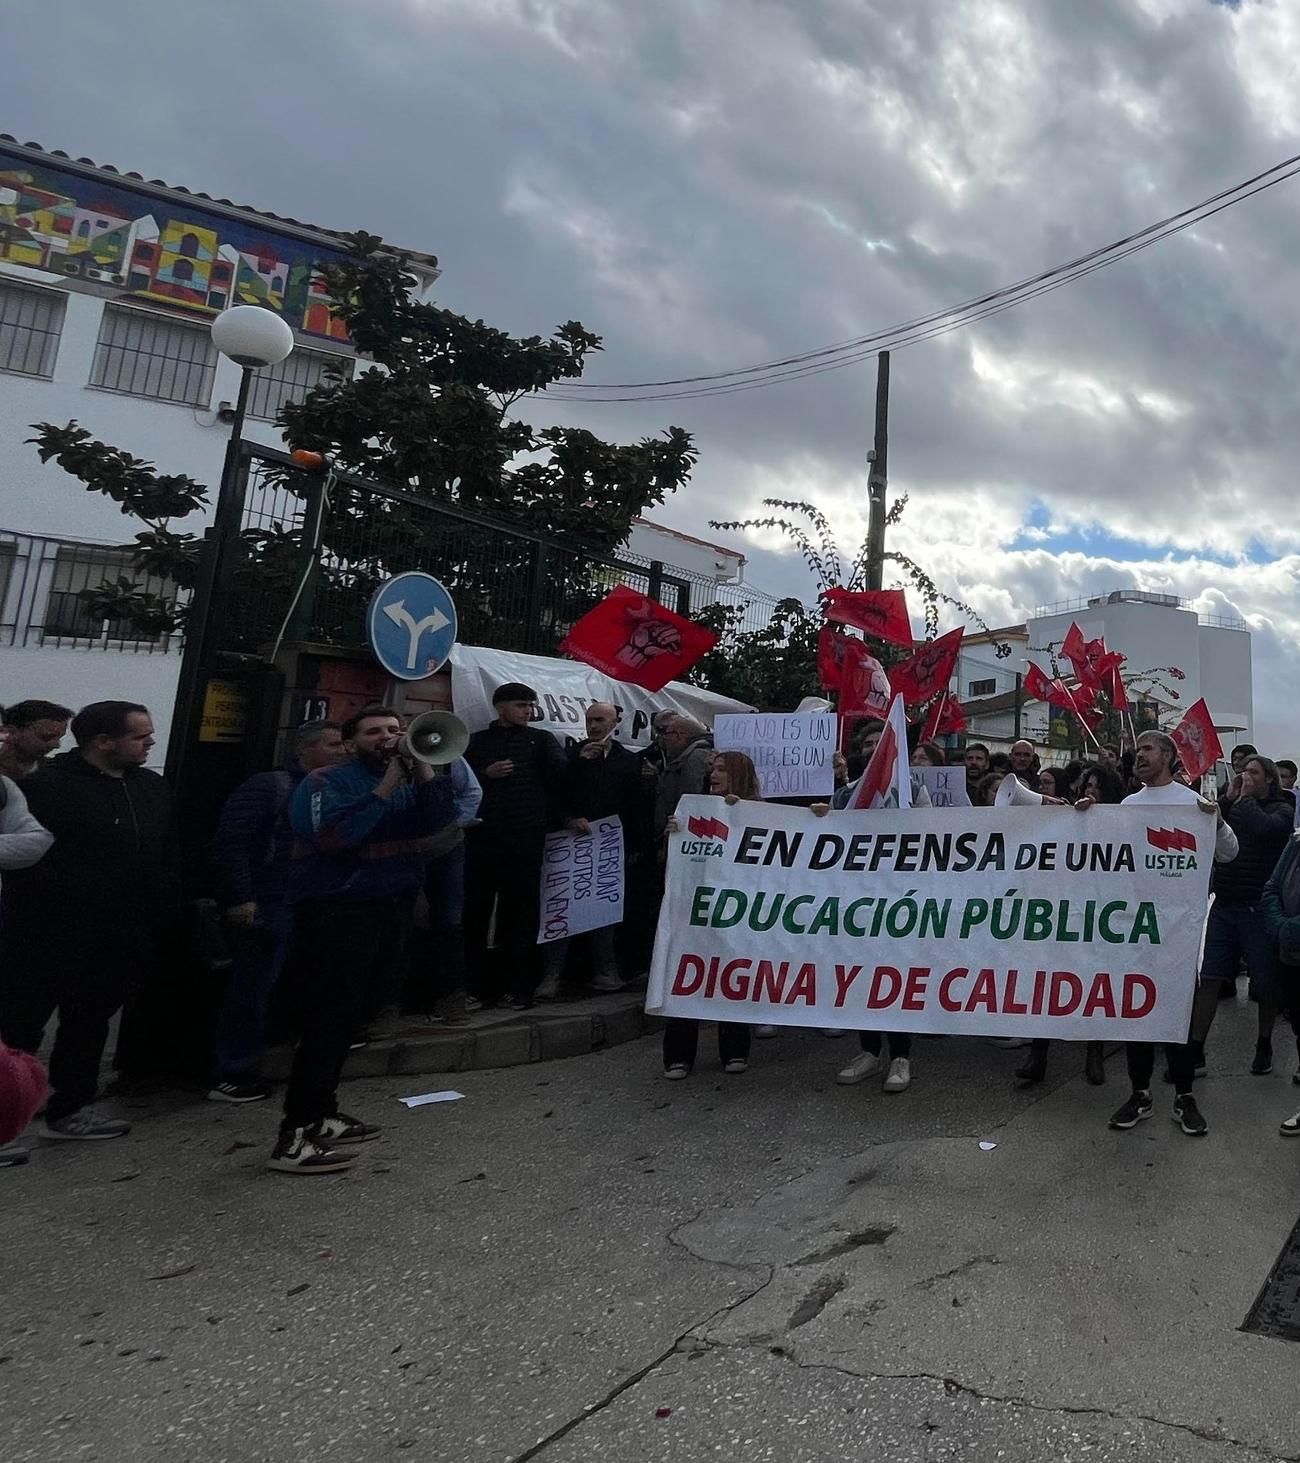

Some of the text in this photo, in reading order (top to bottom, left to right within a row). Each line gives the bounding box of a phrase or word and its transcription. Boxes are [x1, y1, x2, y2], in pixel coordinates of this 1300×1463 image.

[304, 700, 327, 721] 13
[753, 719, 777, 740] NO
[782, 718, 802, 740] ES
[809, 718, 831, 741] UN
[782, 746, 801, 766] ES
[804, 747, 825, 767] UN
[681, 841, 724, 858] USTEA
[734, 827, 1136, 873] EN DEFENSA DE UNA
[1145, 854, 1198, 870] USTEA
[543, 835, 571, 939] NO LA VEMOS
[689, 886, 1162, 945] EDUCACIÓN PÚBLICA
[671, 953, 1157, 1019] DIGNA Y DE CALIDAD
